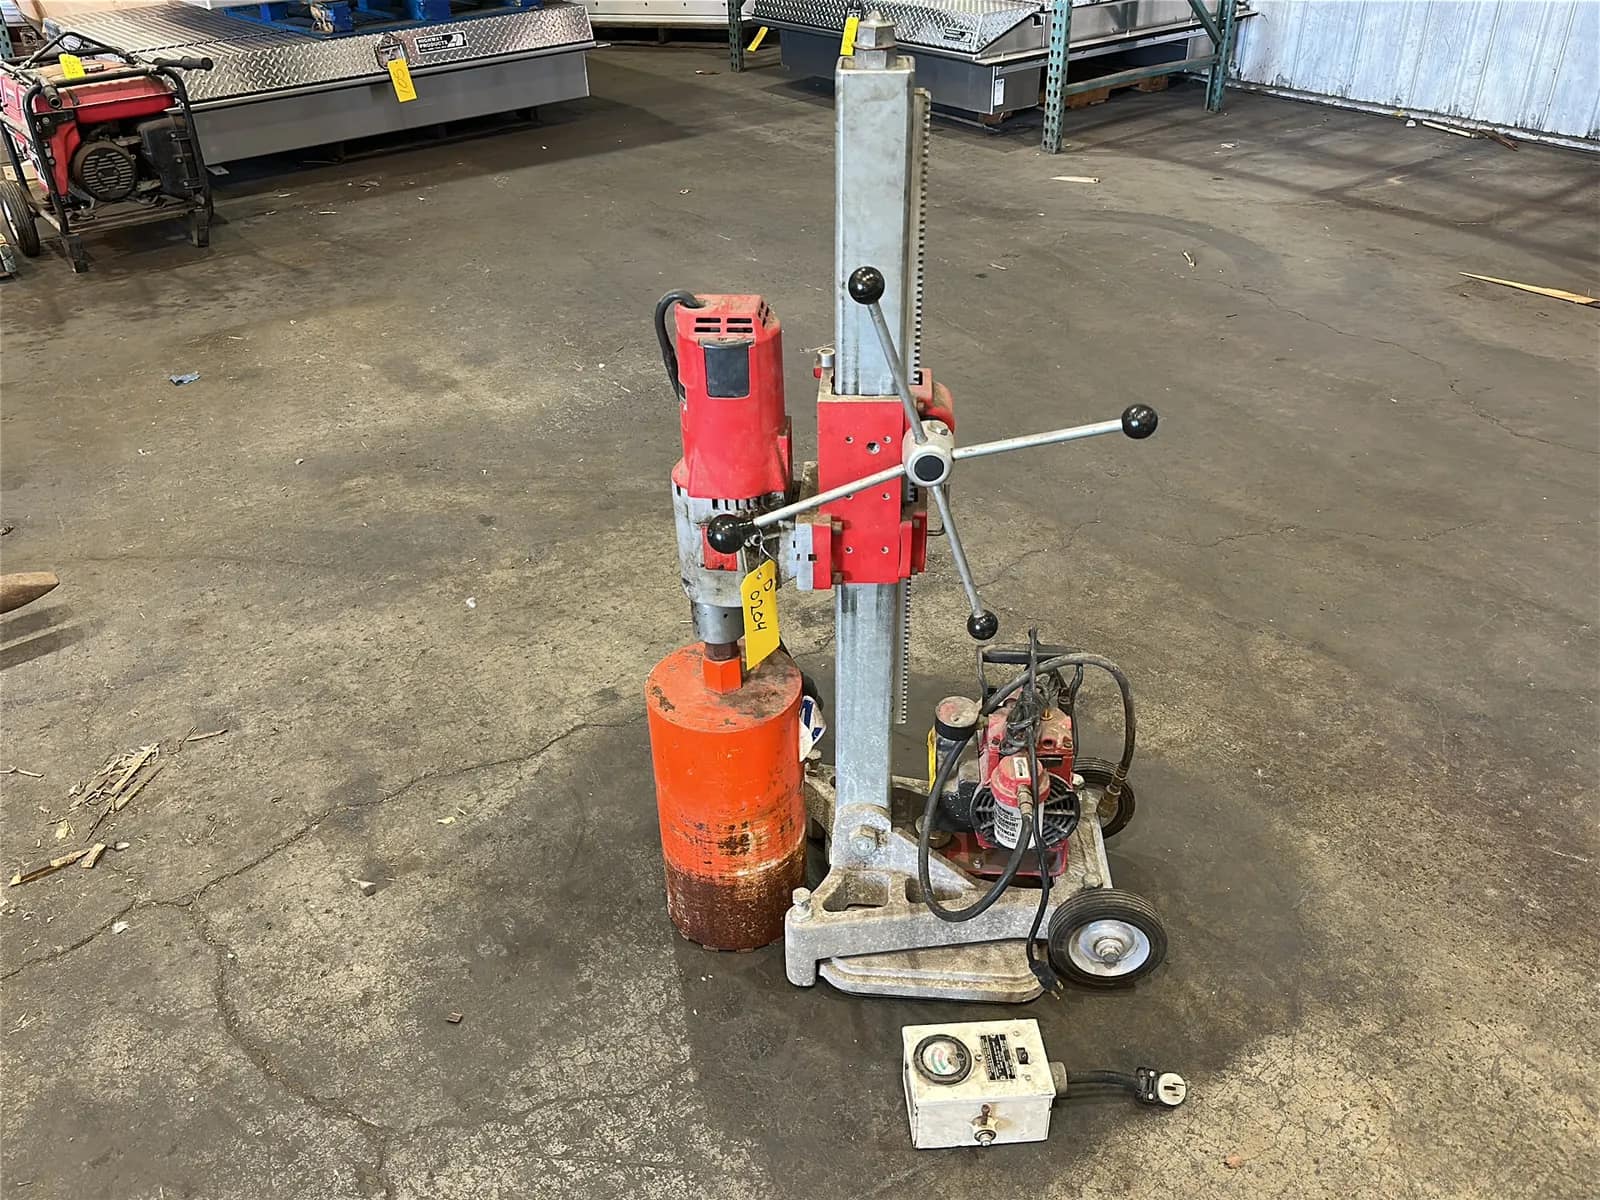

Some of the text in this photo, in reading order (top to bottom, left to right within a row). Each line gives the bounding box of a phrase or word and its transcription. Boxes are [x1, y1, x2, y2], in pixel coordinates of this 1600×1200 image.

[418, 36, 443, 44] HIGHWAY
[419, 40, 448, 48] PRODUCTS
[750, 590, 767, 632] 0204
